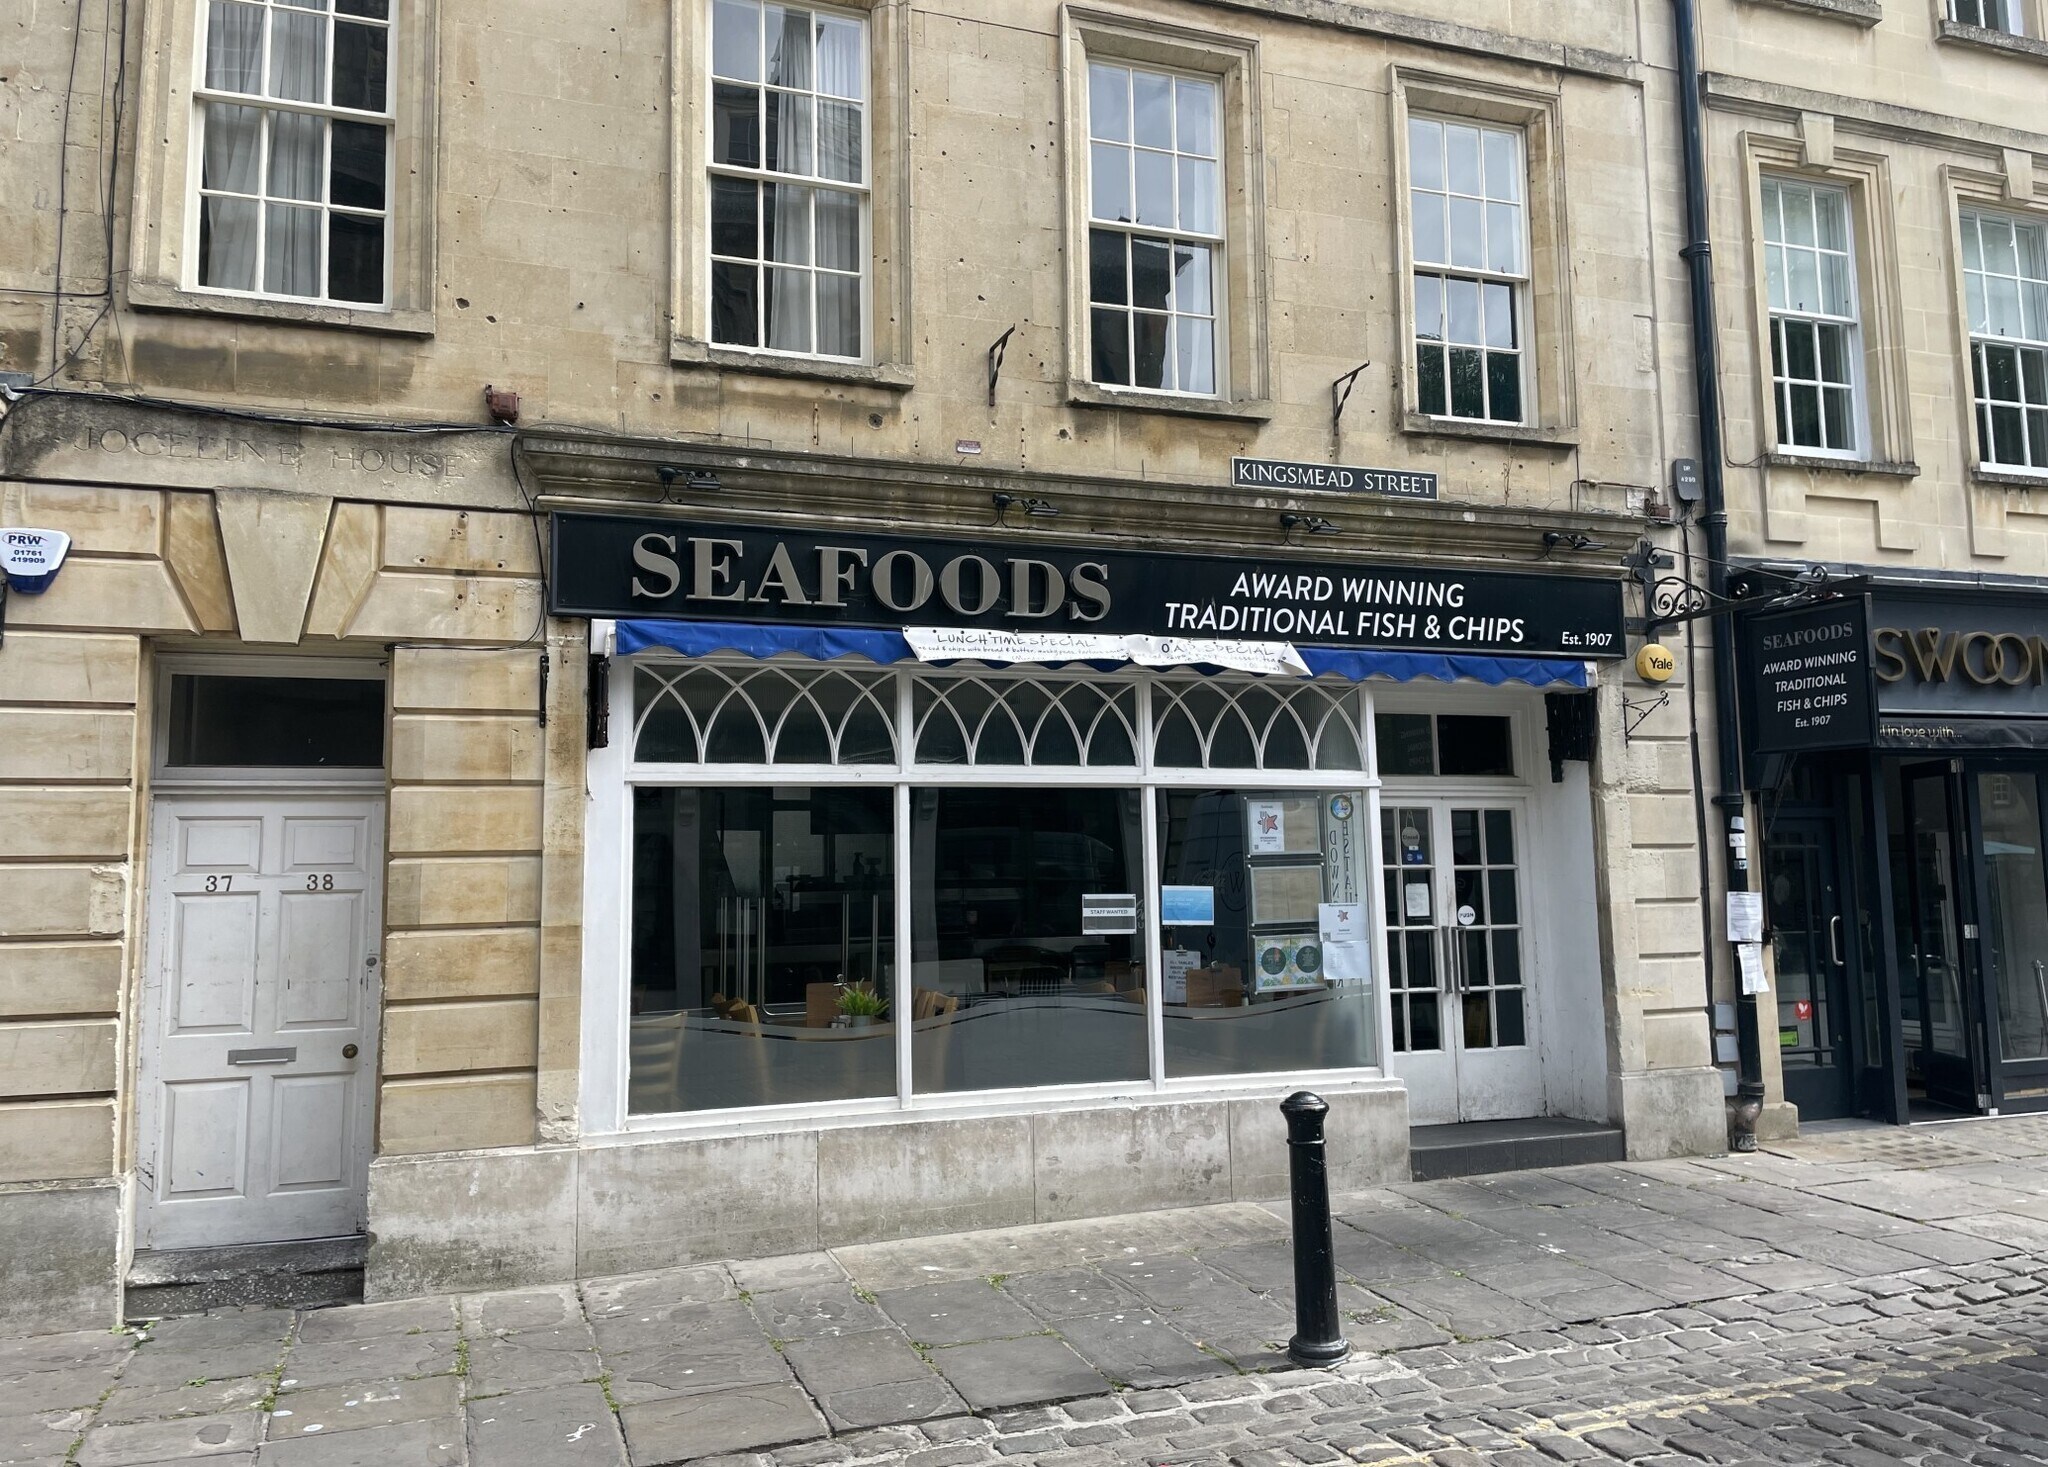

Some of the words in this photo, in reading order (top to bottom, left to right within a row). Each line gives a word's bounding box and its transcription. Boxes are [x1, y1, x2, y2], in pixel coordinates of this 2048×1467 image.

[74, 426, 300, 466] JOCELINE
[330, 446, 465, 478] HOUSE
[1239, 463, 1353, 488] KINGSMEAD
[1364, 473, 1433, 494] STREET
[8, 534, 41, 545] PRW
[631, 532, 1113, 622] SEAFOODS
[1230, 572, 1333, 601] AWARD
[1342, 577, 1465, 608] WINNING
[1165, 602, 1349, 636] TRADITIONAL
[1357, 612, 1416, 639] FISH
[1424, 614, 1441, 640] &
[1449, 615, 1525, 643] CHIPS
[937, 634, 987, 645] LUNCH
[990, 635, 1026, 646] TIME
[1029, 637, 1097, 647] SPECIAL
[1562, 630, 1582, 646] Est.
[1585, 631, 1613, 647] 1907
[1763, 622, 1853, 650] SEAFOODS
[1203, 644, 1275, 656] SPECIAL
[1649, 656, 1673, 670] Yale
[1762, 659, 1802, 675] AWARD
[1804, 650, 1857, 669] WINNING
[1775, 673, 1847, 693] TRADITIONAL
[1777, 699, 1801, 713] FISH
[1803, 697, 1811, 710] &
[1813, 693, 1847, 708] CHIPS
[1795, 717, 1810, 728] Est.
[1811, 715, 1831, 727] 1907
[1888, 724, 1899, 737] in
[1901, 724, 1926, 738] love
[205, 875, 233, 893] 37
[306, 874, 334, 891] 38
